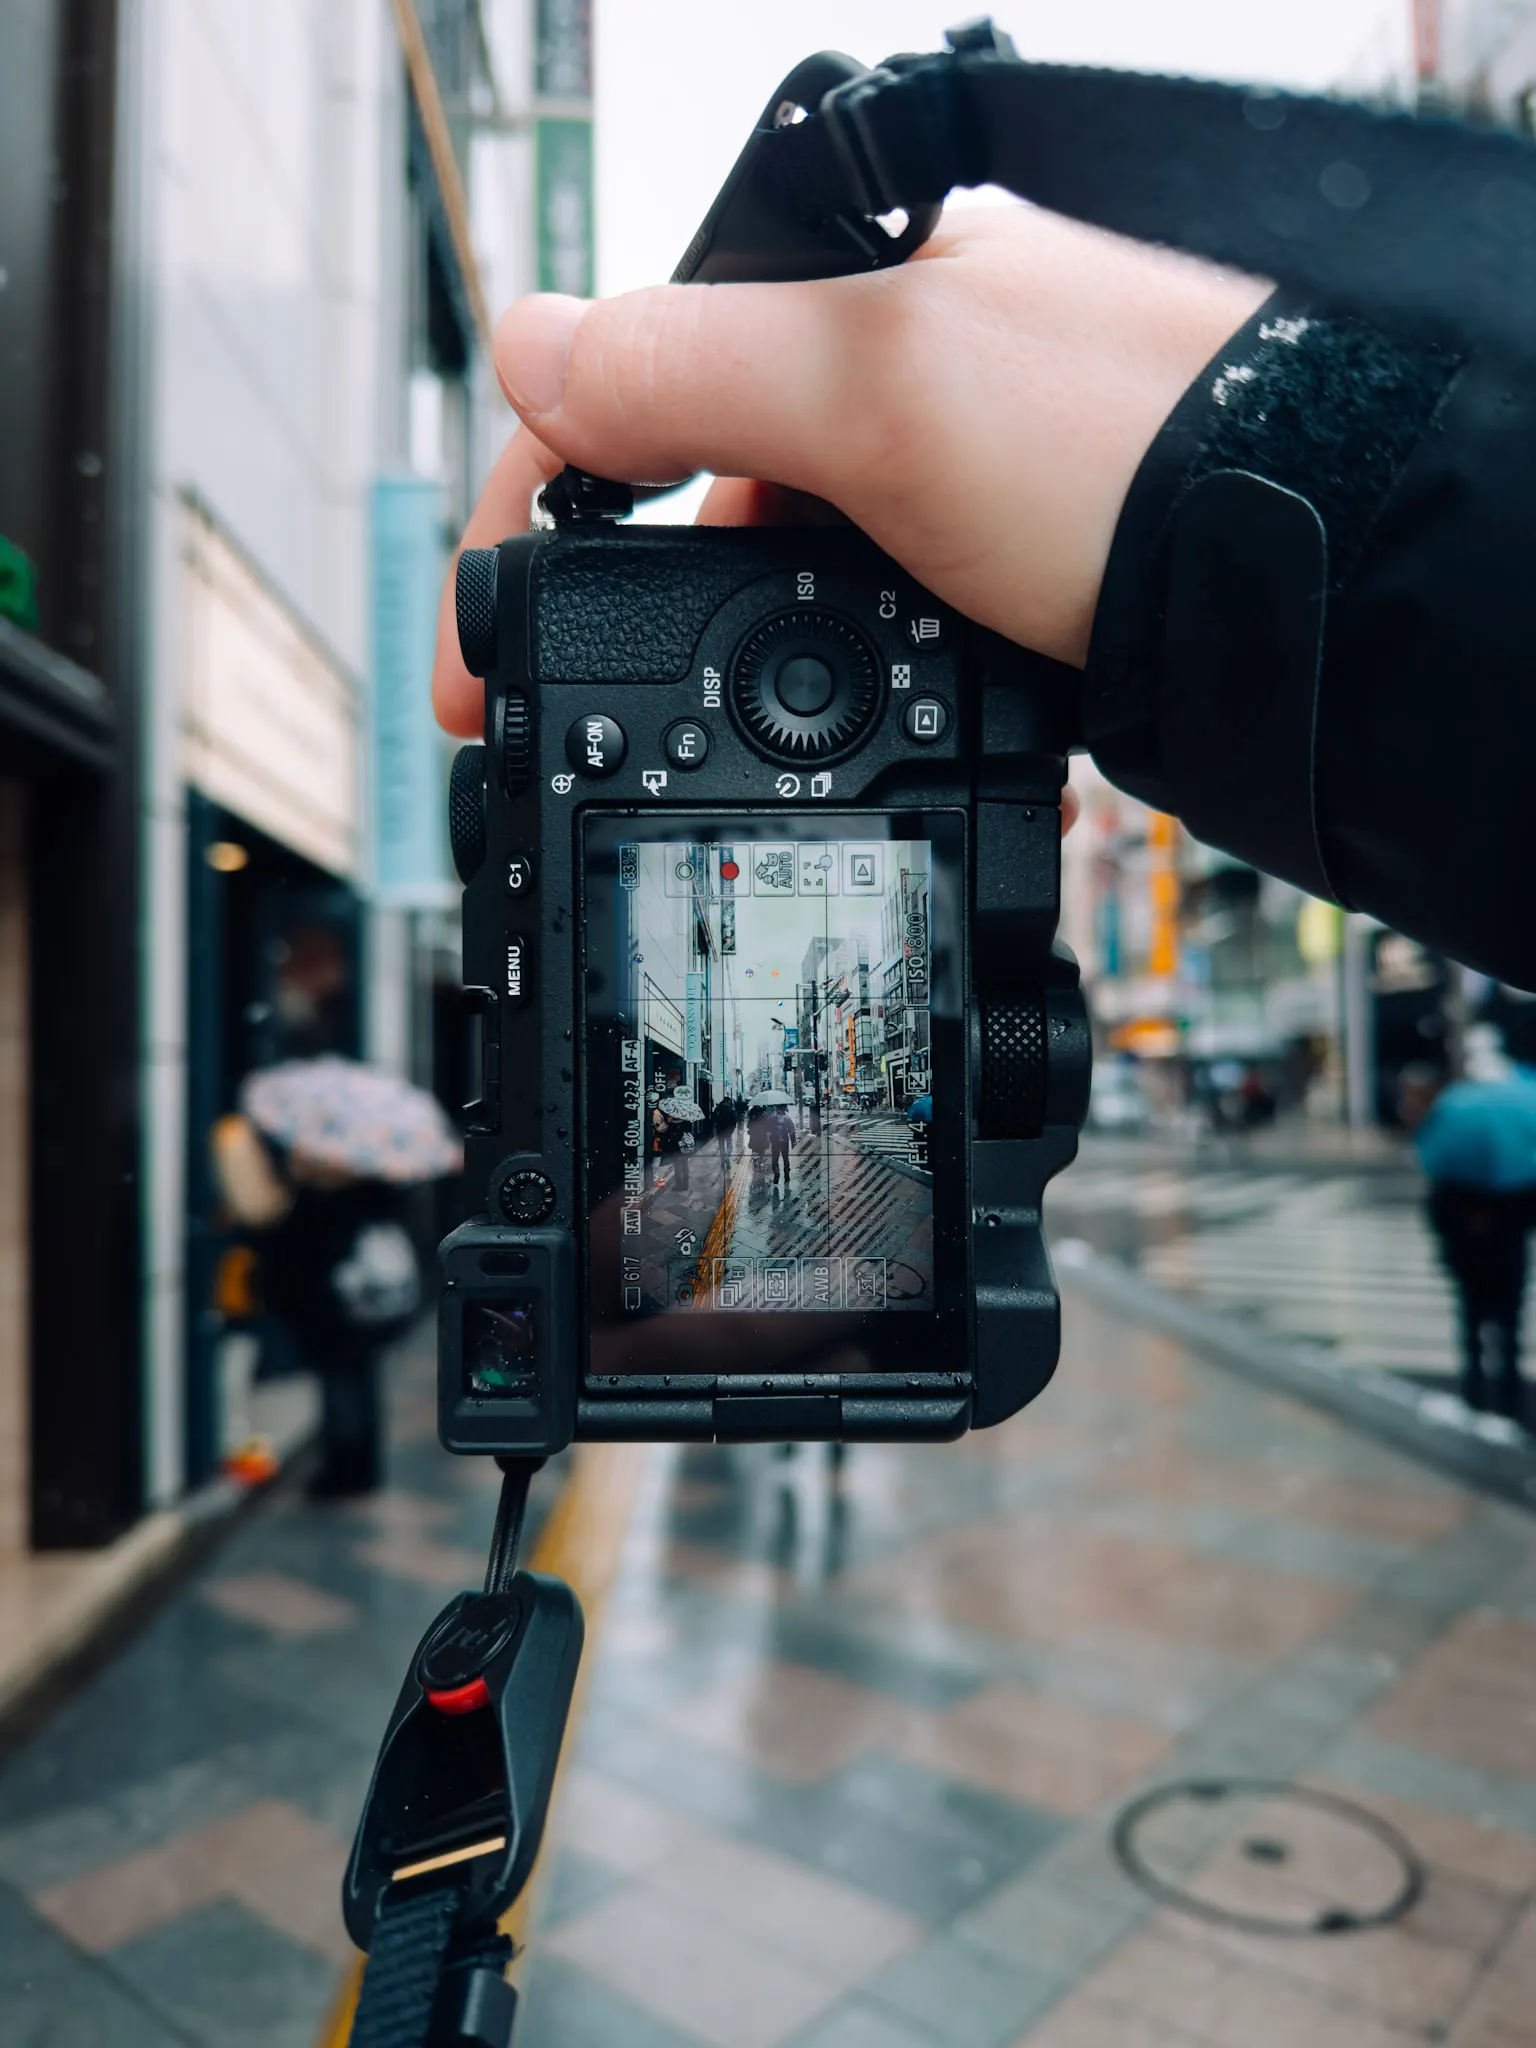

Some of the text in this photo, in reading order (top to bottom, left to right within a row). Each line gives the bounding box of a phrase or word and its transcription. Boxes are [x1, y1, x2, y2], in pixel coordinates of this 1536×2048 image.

[797, 572, 814, 600] ISO
[879, 590, 896, 619] C2
[703, 666, 721, 708] DISP
[587, 721, 604, 768] AF-ON
[678, 733, 695, 758] Fn
[509, 863, 522, 888] C1
[623, 853, 636, 880] 83%
[779, 851, 792, 888] AUTO
[907, 912, 925, 983] ISO 800
[507, 945, 521, 996] MENU
[625, 1041, 638, 1070] AF-A
[624, 1079, 639, 1111] 4:2:2
[655, 1071, 666, 1092] OFF
[626, 1210, 639, 1234] RAW
[623, 1256, 640, 1281] 617
[814, 1266, 829, 1303] AWB
